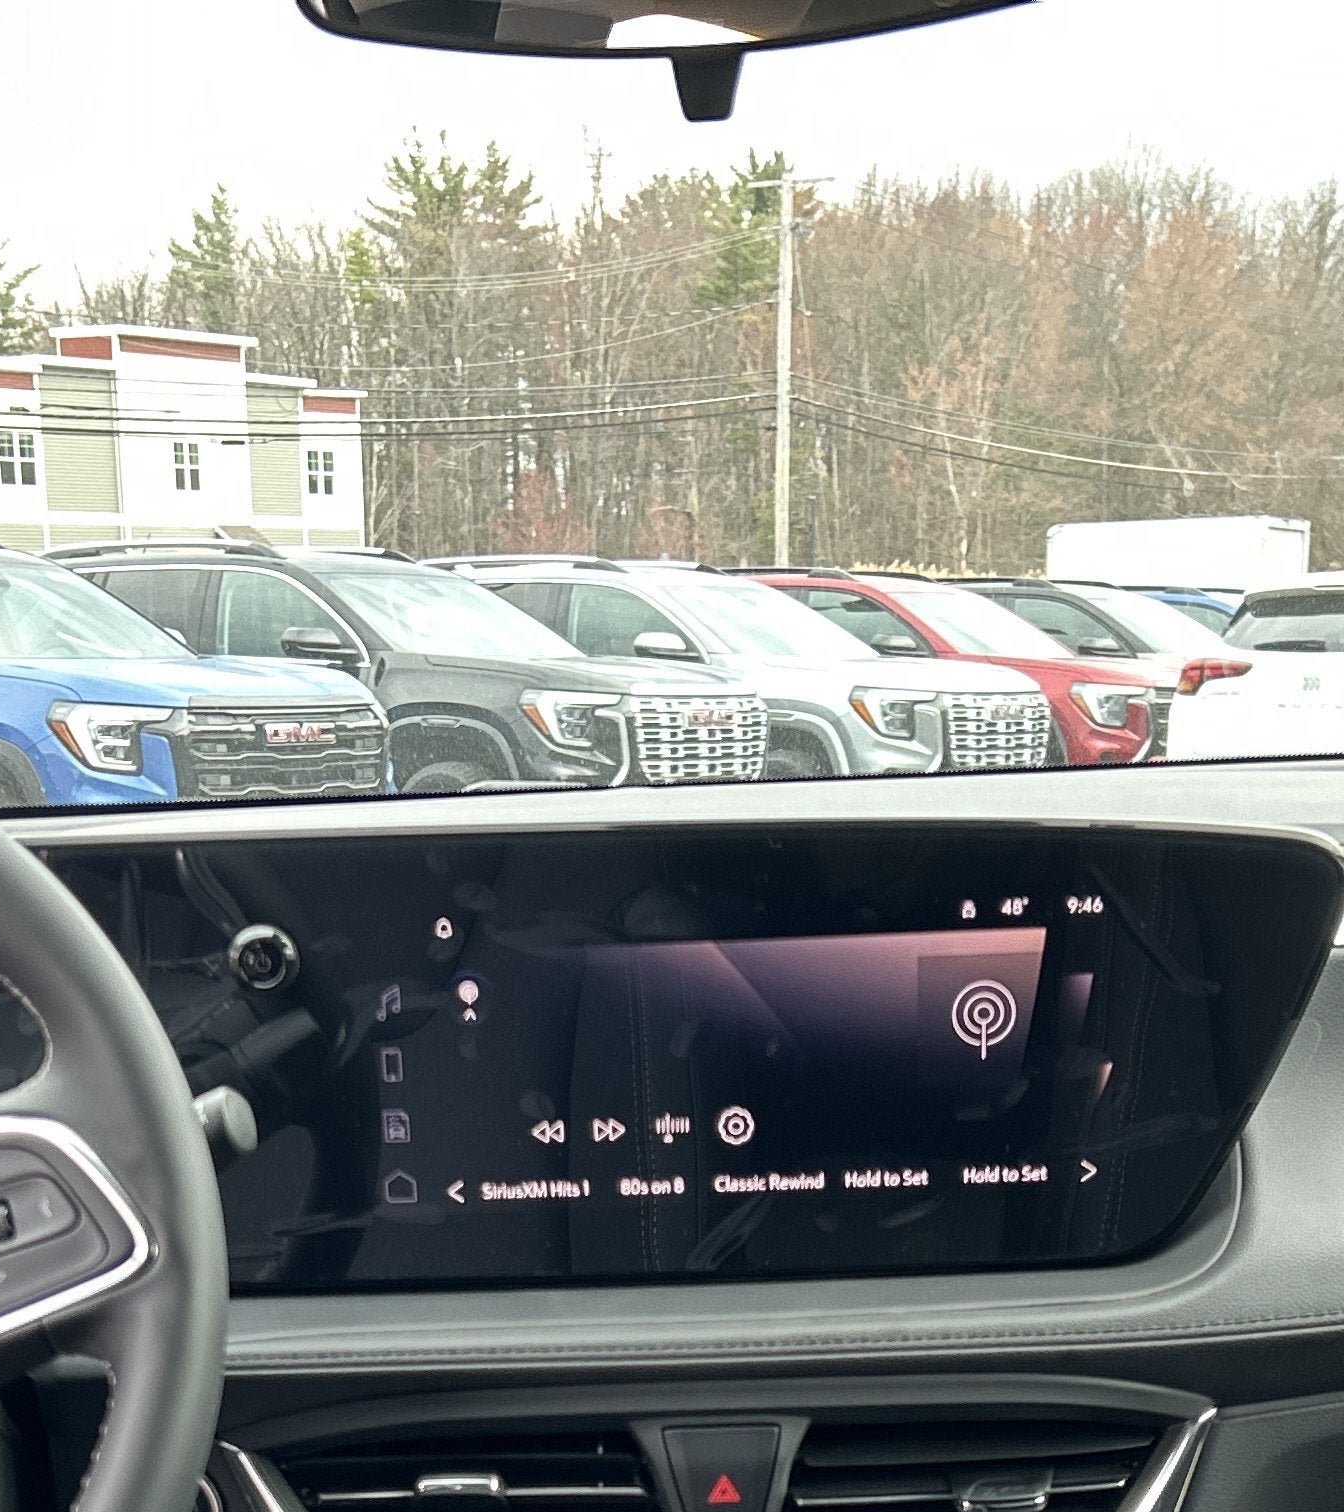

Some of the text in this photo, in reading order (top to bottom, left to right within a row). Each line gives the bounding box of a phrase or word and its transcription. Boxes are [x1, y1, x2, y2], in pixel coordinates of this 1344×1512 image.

[263, 721, 337, 746] GMC
[1067, 895, 1104, 915] 9:46
[713, 1172, 825, 1193] Classic Rewind
[844, 1168, 929, 1188] Hold to Set
[962, 1165, 1049, 1185] Hold to Set
[482, 1178, 590, 1200] SiriusXM Hits 1
[620, 1176, 685, 1196] 80s on 8
